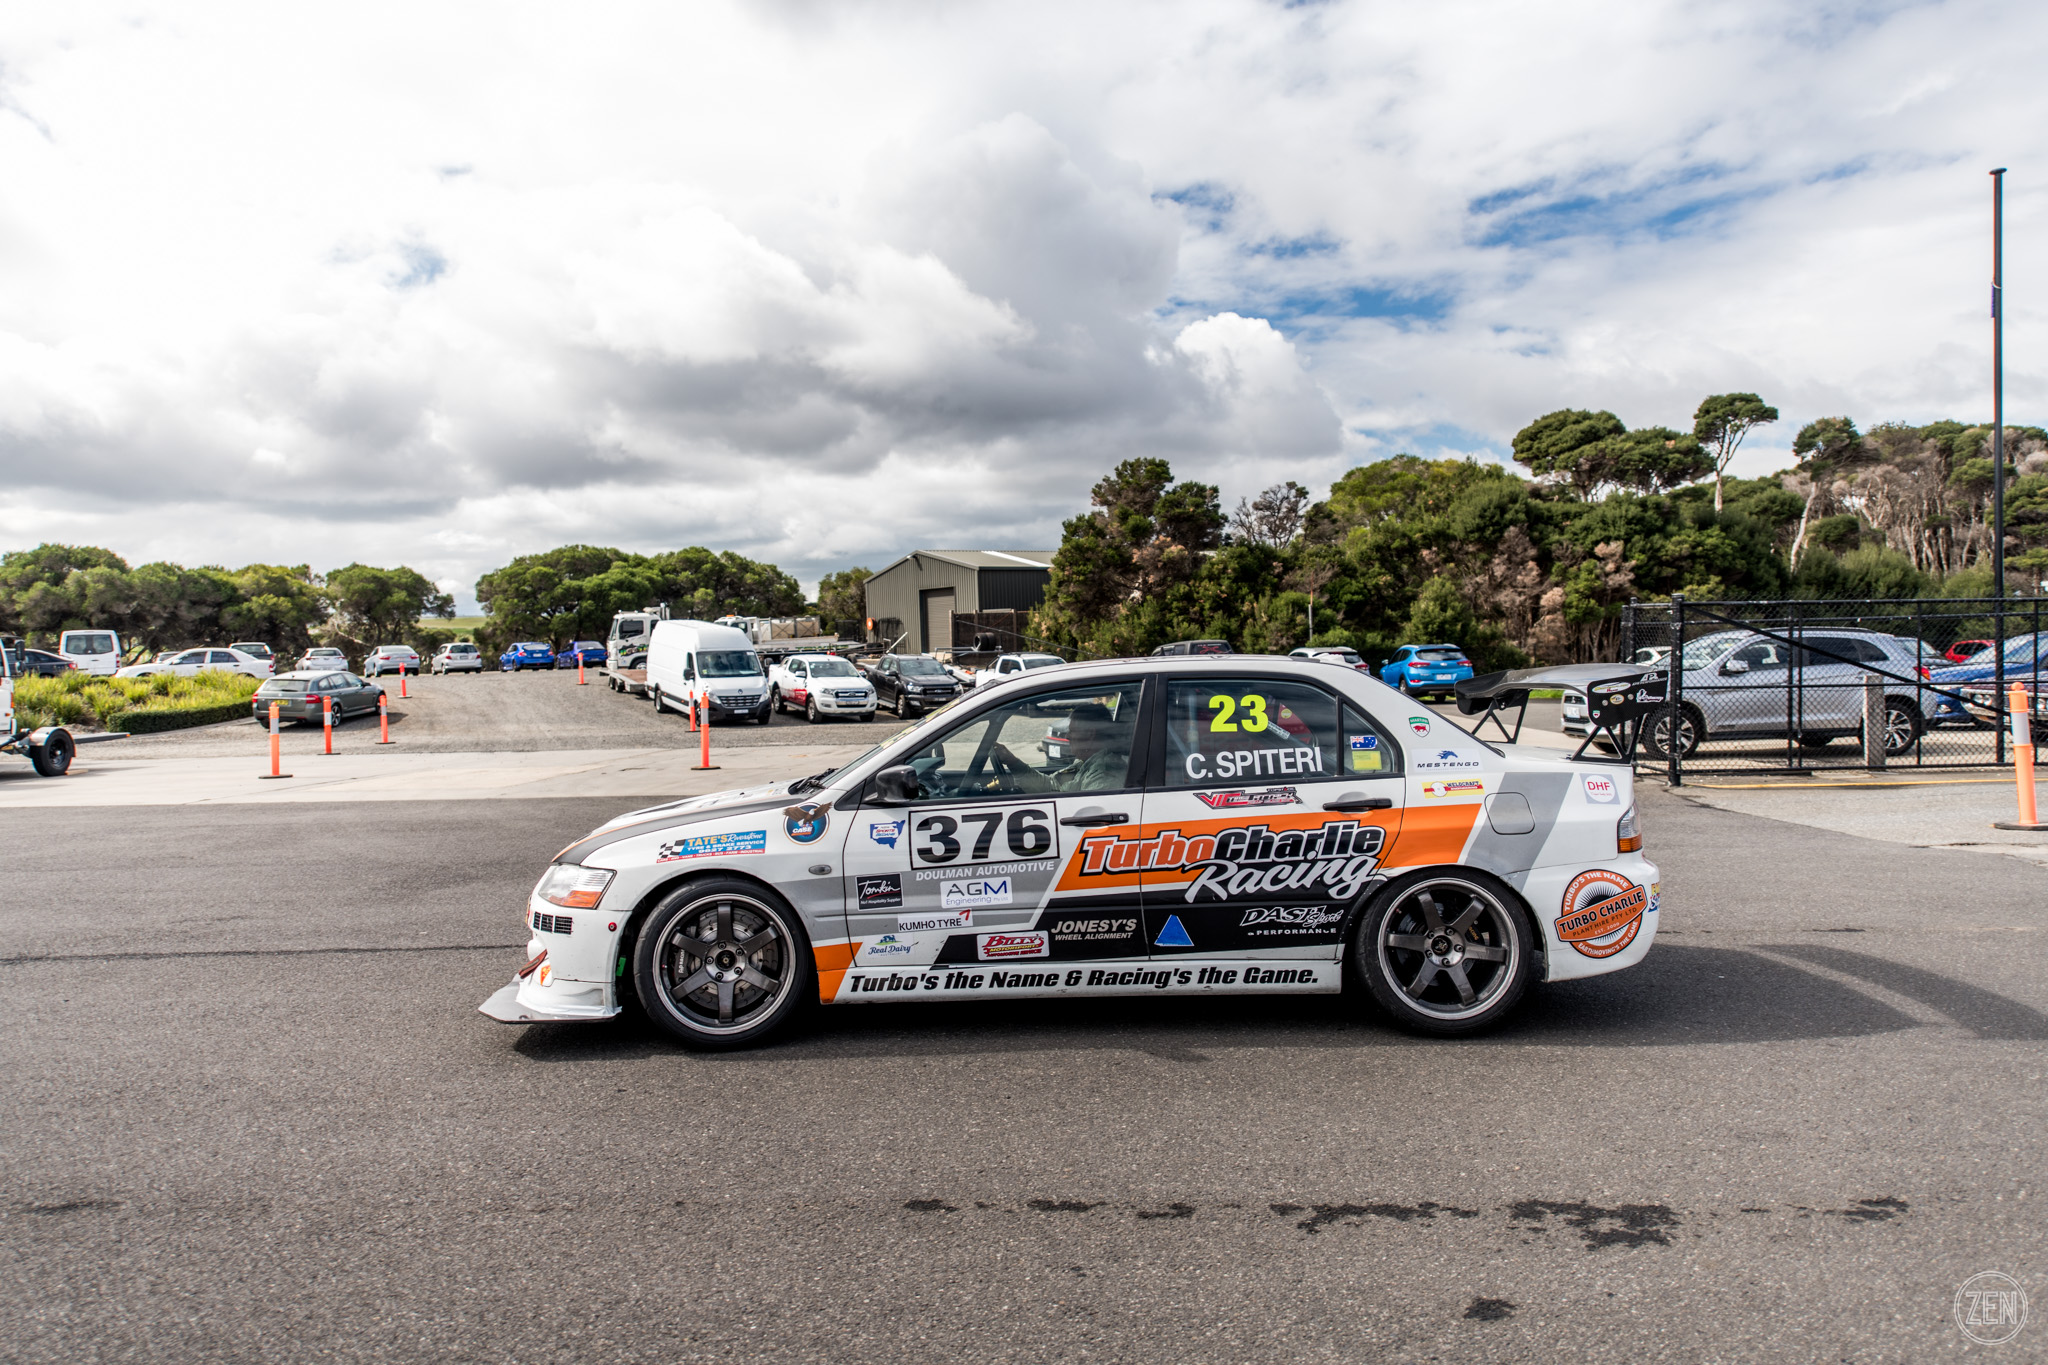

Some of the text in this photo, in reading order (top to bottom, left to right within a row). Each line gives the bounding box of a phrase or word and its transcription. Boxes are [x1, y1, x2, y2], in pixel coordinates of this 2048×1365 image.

[1208, 694, 1269, 733] 23
[1587, 781, 1610, 791] DHF
[687, 834, 728, 847] TATE'S
[915, 809, 1052, 864] 376
[915, 861, 1055, 881] DOULMAN AUTOMOTIVE
[1183, 850, 1383, 904] Racing
[858, 880, 901, 899] Tomkin
[946, 880, 1008, 897] AGM
[1564, 872, 1629, 912] TURBO'S THE NAME
[945, 895, 991, 906] Engineering
[1239, 905, 1344, 928] DASH Sport
[1559, 911, 1598, 934] TURBO
[1599, 891, 1644, 917] CHARLIE
[1572, 907, 1638, 937] PLANT HIRE PTY LTD
[899, 917, 962, 931] KUMHO TYRE
[1050, 918, 1138, 934] JONESY'S
[982, 933, 1045, 948] BILLY'S
[1054, 932, 1133, 941] WHEEL ALIGNMENT
[1578, 921, 1638, 956] EARTHMOVING'S THE GAME
[868, 943, 912, 955] Real Dairy
[850, 966, 1319, 992] Turbo's the Name & Racing's the Game.
